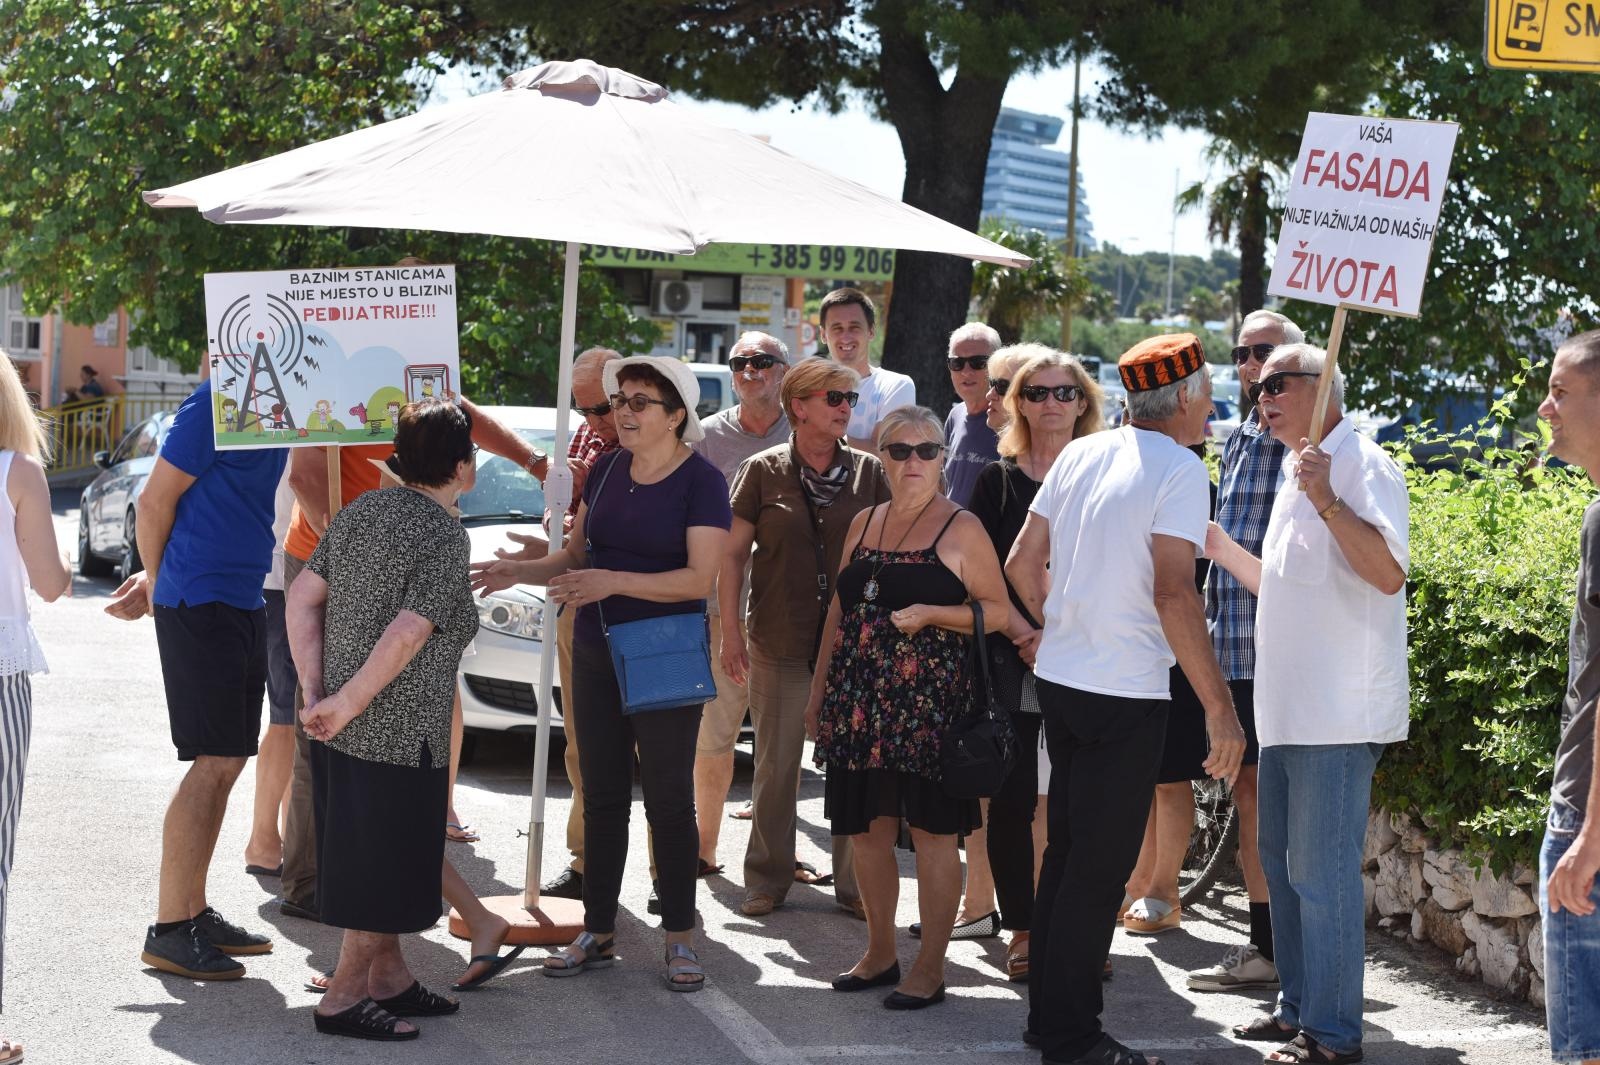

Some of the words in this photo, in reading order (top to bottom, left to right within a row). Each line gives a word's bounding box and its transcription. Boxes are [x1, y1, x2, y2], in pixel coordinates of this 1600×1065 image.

[1513, 3, 1537, 30] P
[1359, 122, 1393, 144] VAŠA
[1302, 149, 1431, 202] FASADA
[1283, 205, 1312, 225] NIJE
[1314, 208, 1367, 232] VAŽNIJA
[1369, 217, 1390, 235] OD
[1391, 217, 1435, 241] NAŠIH
[819, 246, 847, 271] 99
[854, 249, 893, 274] 206
[290, 271, 350, 285] BAZNIM
[355, 267, 446, 282] STANICAMA
[1286, 240, 1399, 308] ŽIVOTA
[285, 289, 315, 301] NIJE
[320, 287, 379, 300] MJESTO
[383, 286, 394, 298] U
[399, 284, 453, 298] BLIZINI
[303, 303, 436, 323] PEDIJATRIJE!!!
